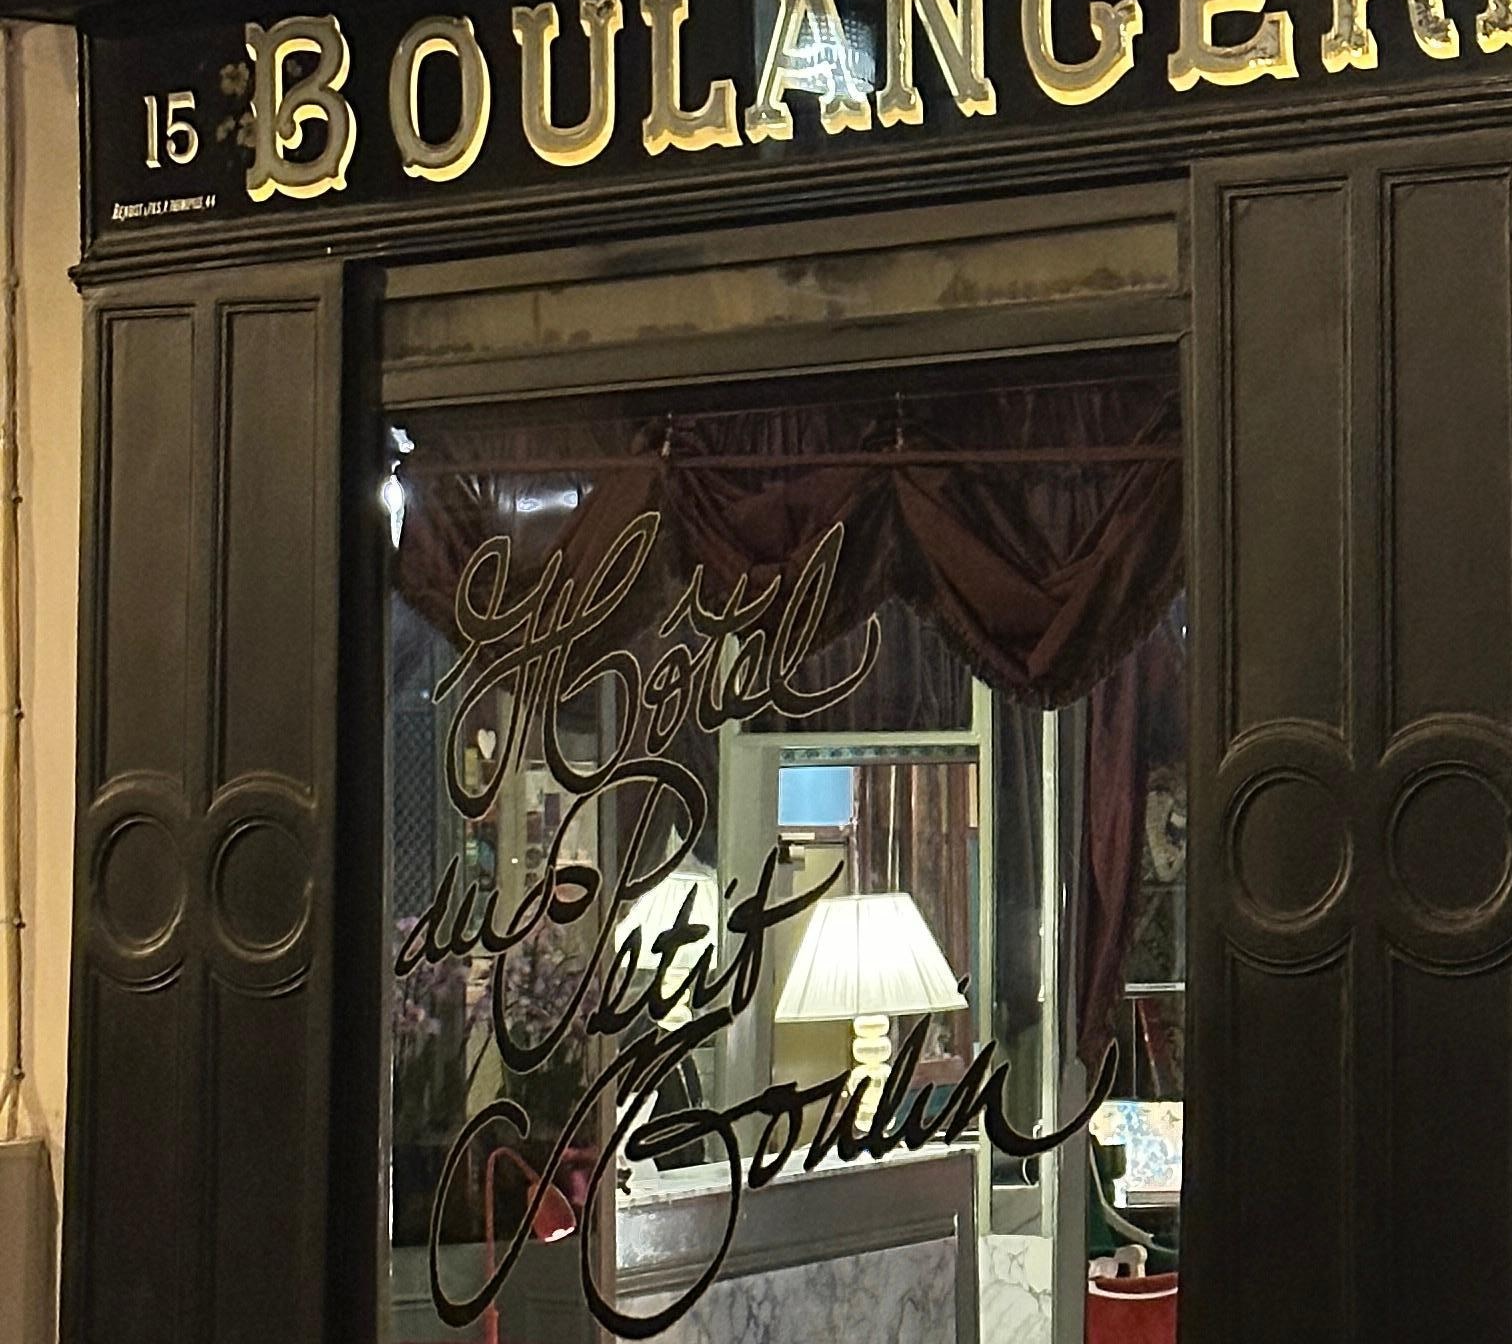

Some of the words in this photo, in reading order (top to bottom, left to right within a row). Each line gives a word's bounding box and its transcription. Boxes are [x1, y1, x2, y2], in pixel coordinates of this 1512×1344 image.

[144, 91, 200, 168] 15
[432, 511, 879, 820] Hôtel
[394, 855, 540, 977] du
[493, 758, 844, 1074] Petit
